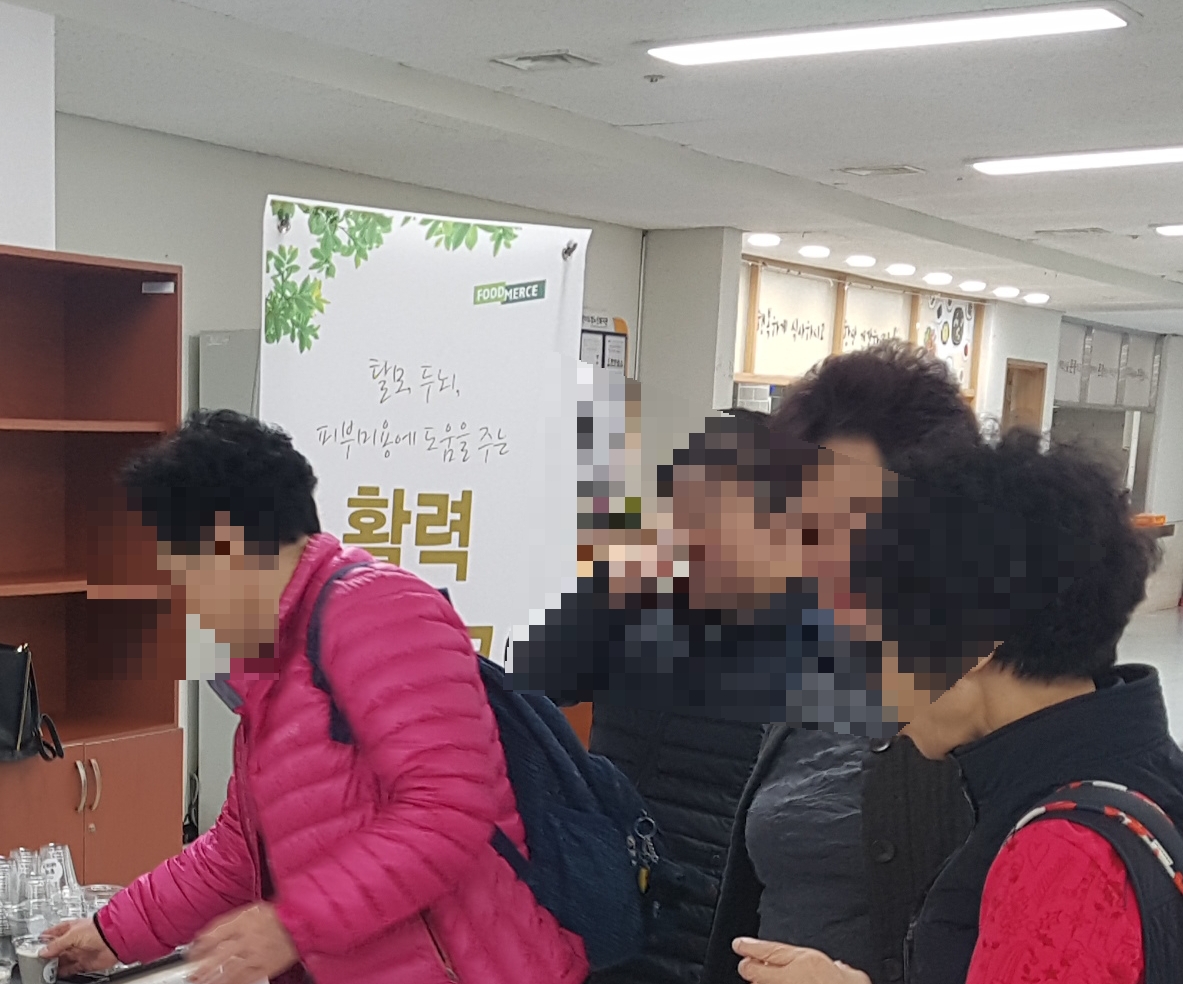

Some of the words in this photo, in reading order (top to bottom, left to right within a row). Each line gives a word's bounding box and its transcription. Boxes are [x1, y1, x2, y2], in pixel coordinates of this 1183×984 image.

[476, 283, 539, 302] FOODMERCE
[316, 419, 416, 460] 피부미용에
[424, 421, 471, 463] 도움을
[478, 426, 510, 464] 주는
[342, 485, 473, 583] 활력
